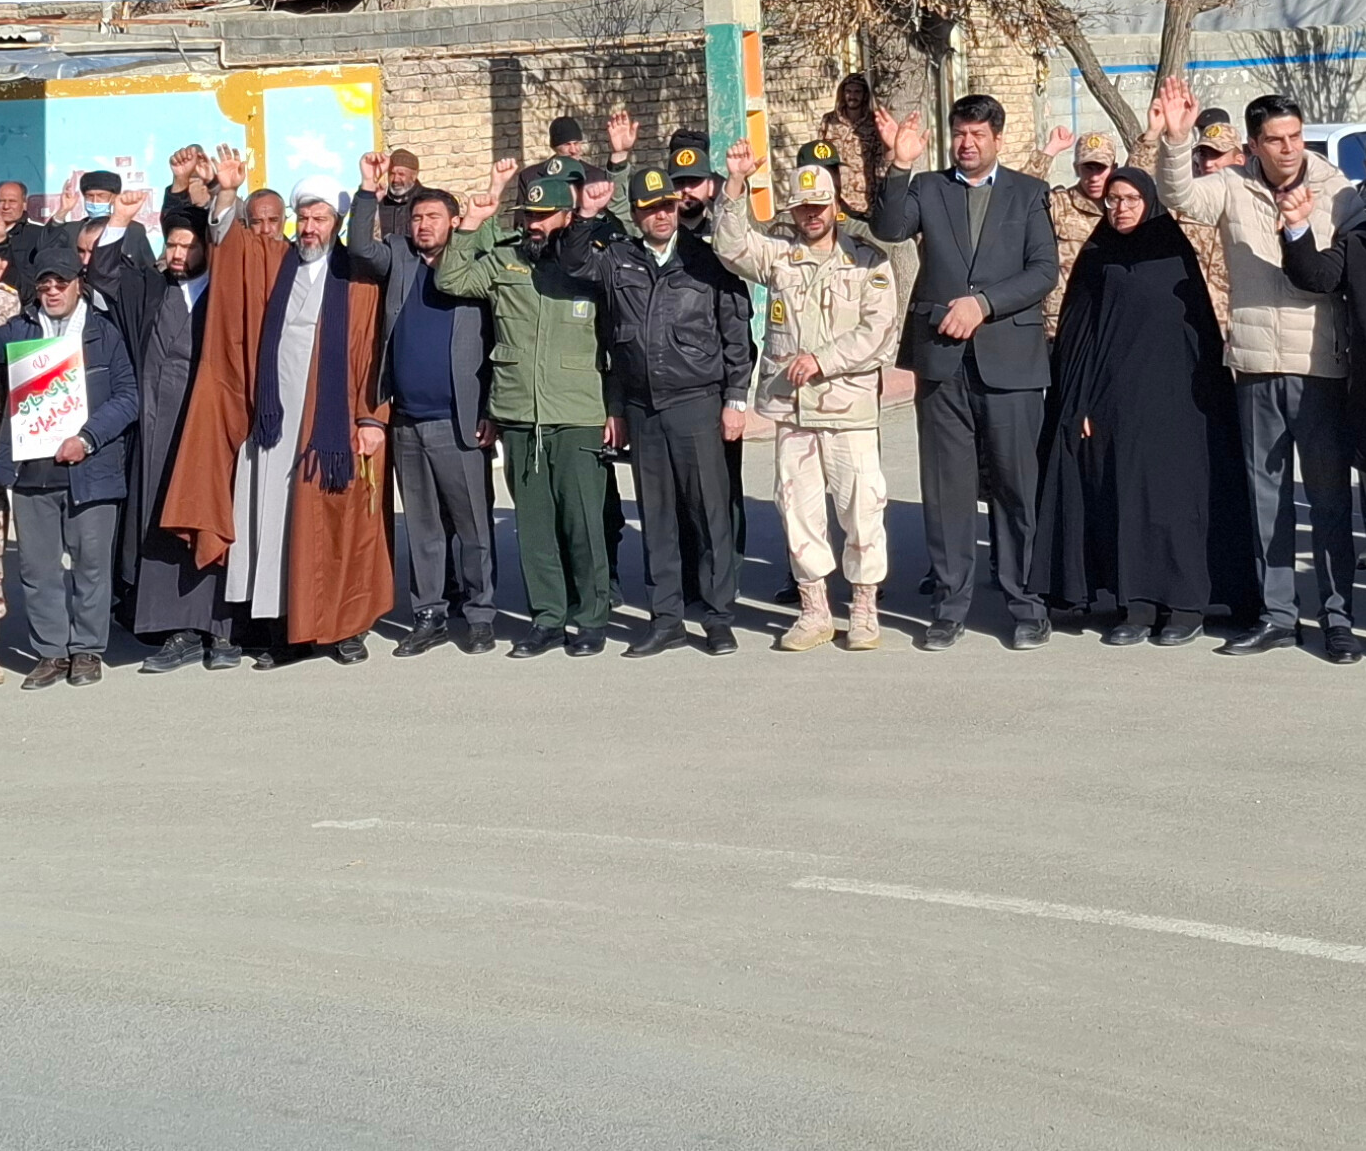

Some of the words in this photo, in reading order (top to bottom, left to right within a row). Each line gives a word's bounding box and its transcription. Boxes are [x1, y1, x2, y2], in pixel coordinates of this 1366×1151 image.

[64, 368, 77, 382] تا
[44, 378, 70, 398] پای
[19, 394, 44, 416] جان
[57, 395, 83, 416] برای
[29, 407, 57, 435] ایران
